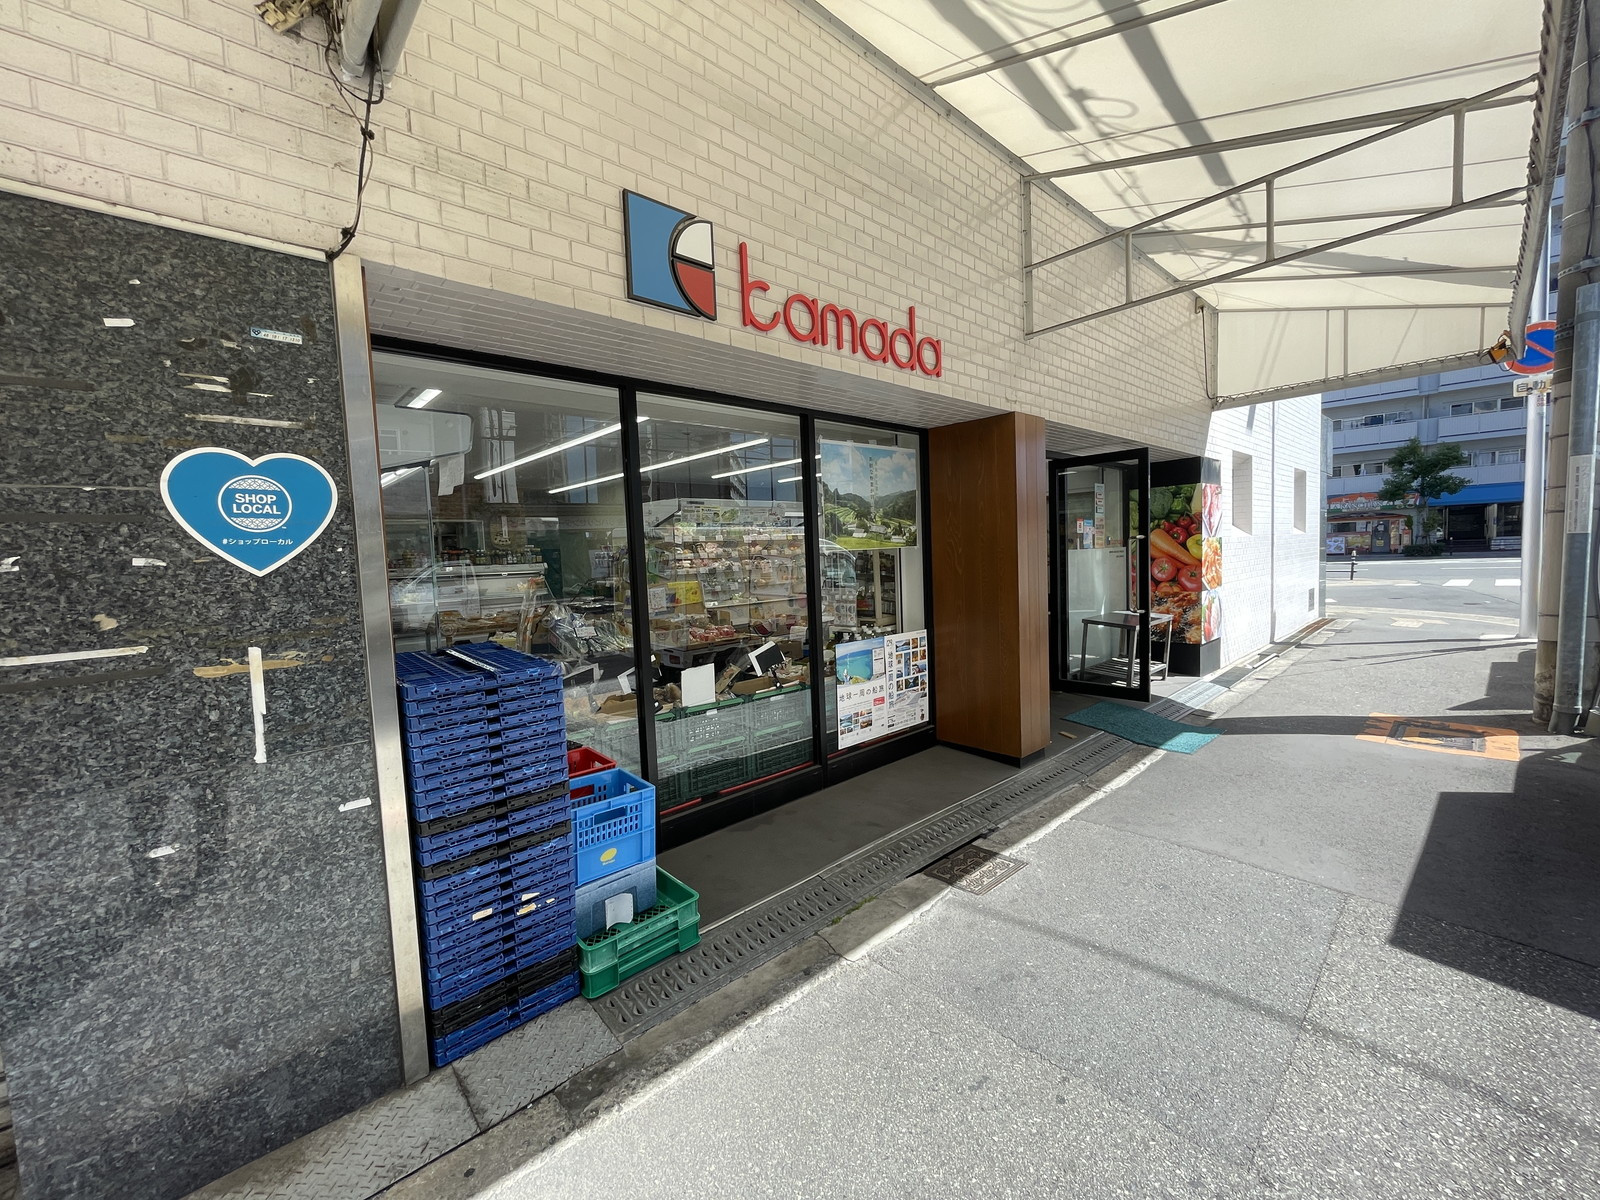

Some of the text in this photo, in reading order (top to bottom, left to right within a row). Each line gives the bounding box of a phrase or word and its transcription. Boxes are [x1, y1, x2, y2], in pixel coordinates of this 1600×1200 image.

[739, 242, 942, 378] tamada
[235, 493, 277, 504] SHOP
[232, 504, 282, 514] LOCAL
[839, 684, 885, 703] 地球一周の船旅
